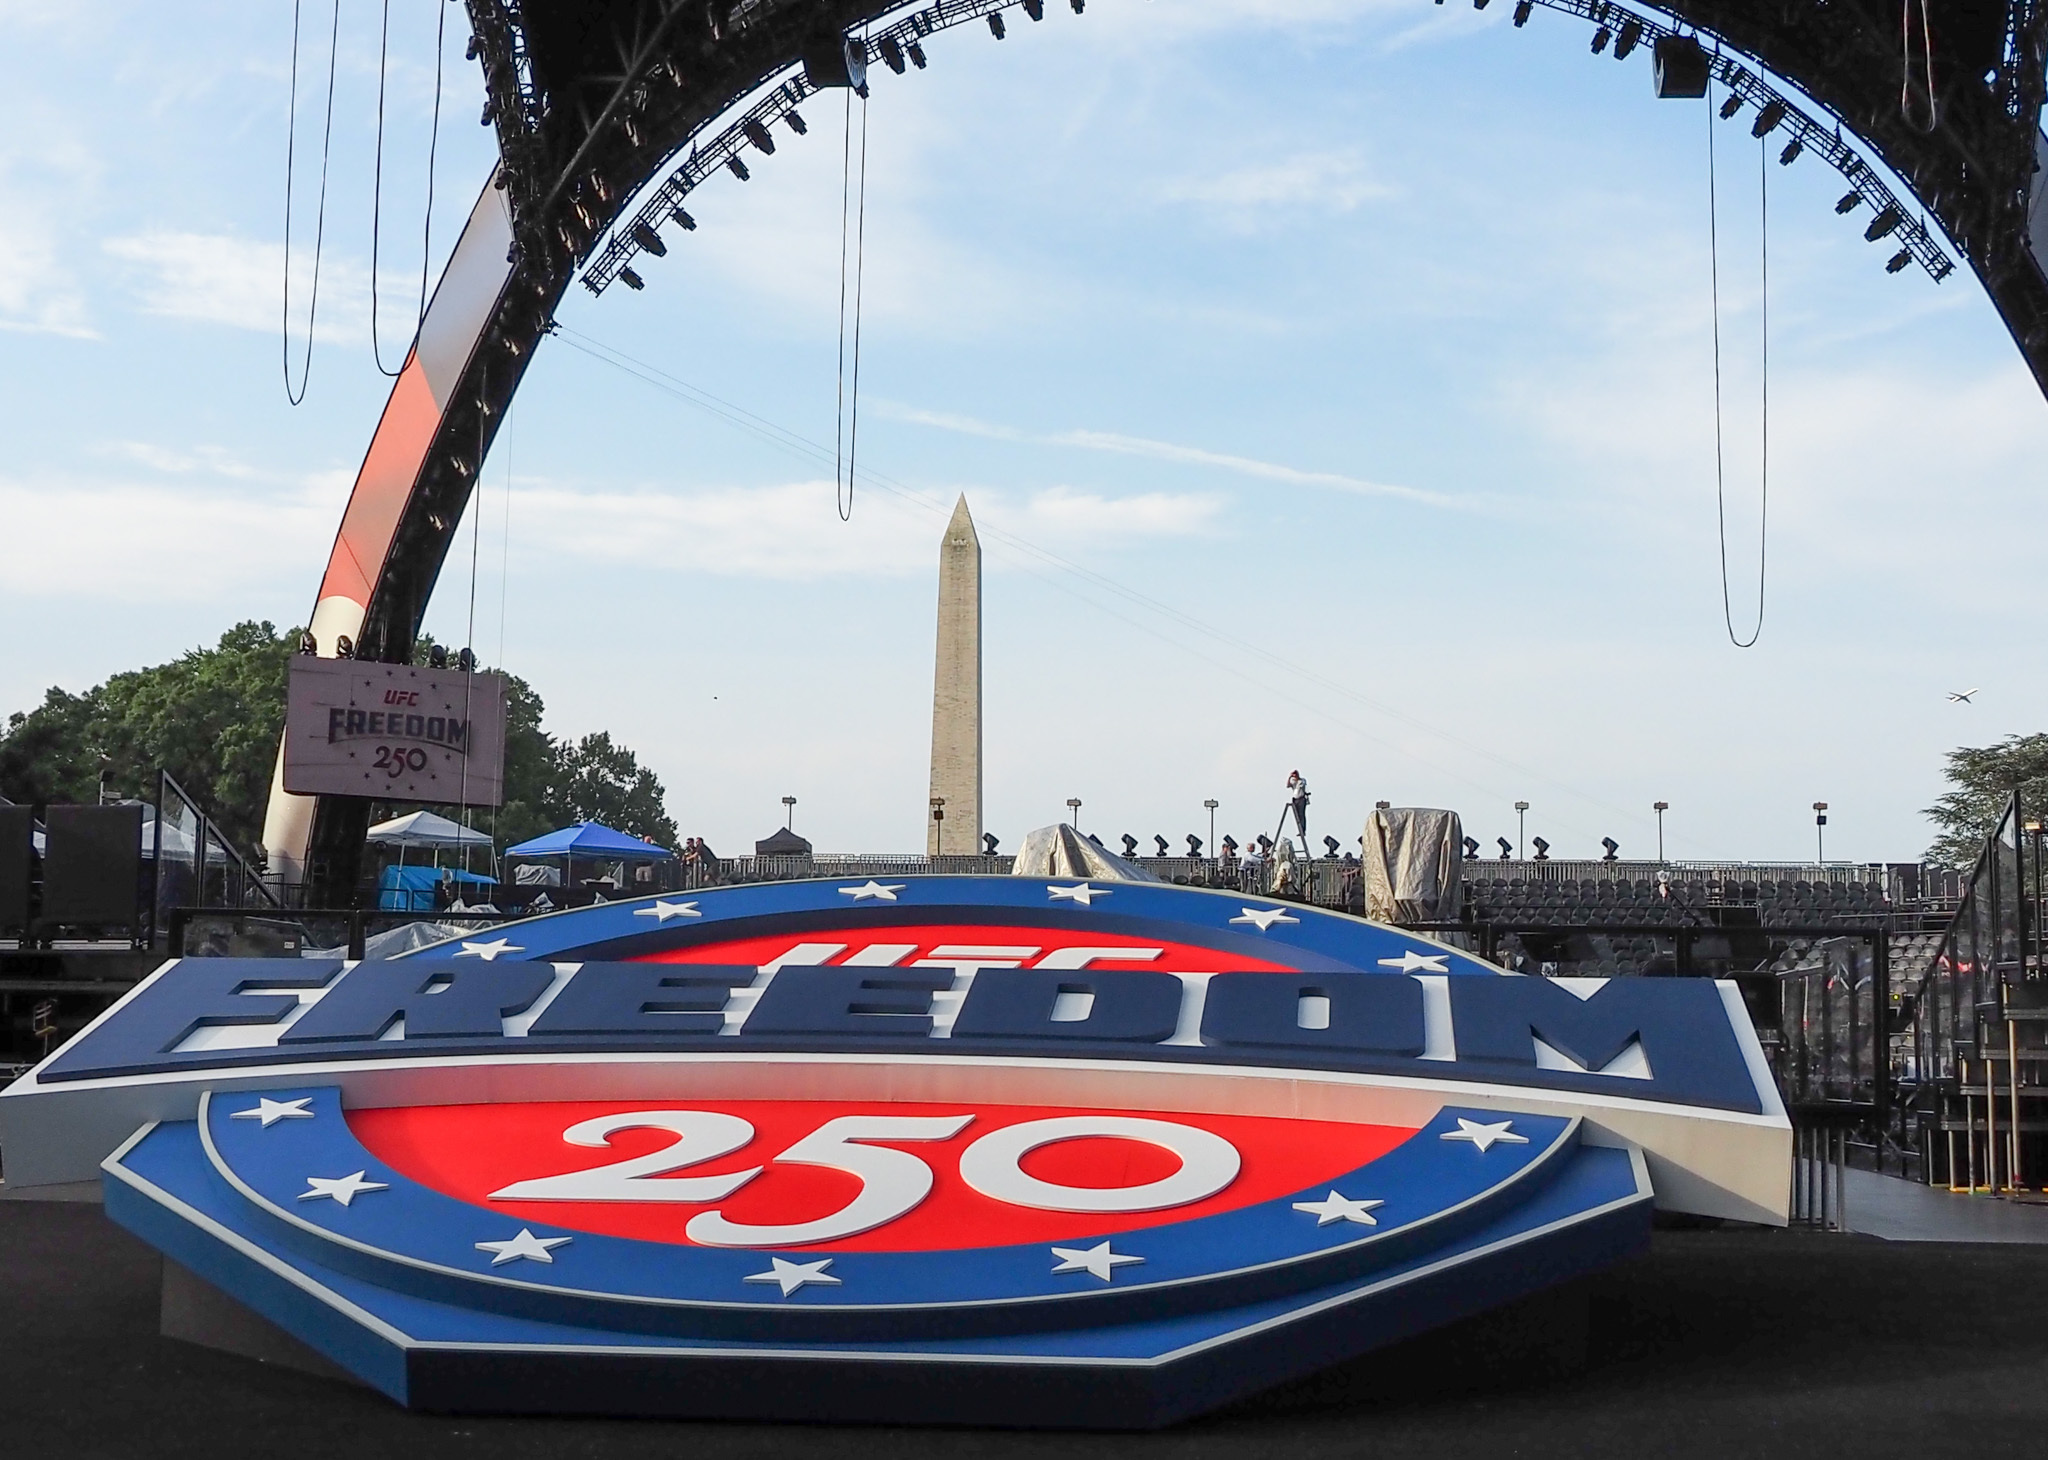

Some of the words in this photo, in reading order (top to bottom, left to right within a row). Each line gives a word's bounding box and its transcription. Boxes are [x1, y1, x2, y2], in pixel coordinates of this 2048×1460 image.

[383, 689, 420, 707] UFC
[328, 707, 471, 757] FREEDOM
[372, 745, 428, 778] 250
[37, 958, 1763, 1116] FREEDOM
[486, 1109, 1242, 1248] 250
